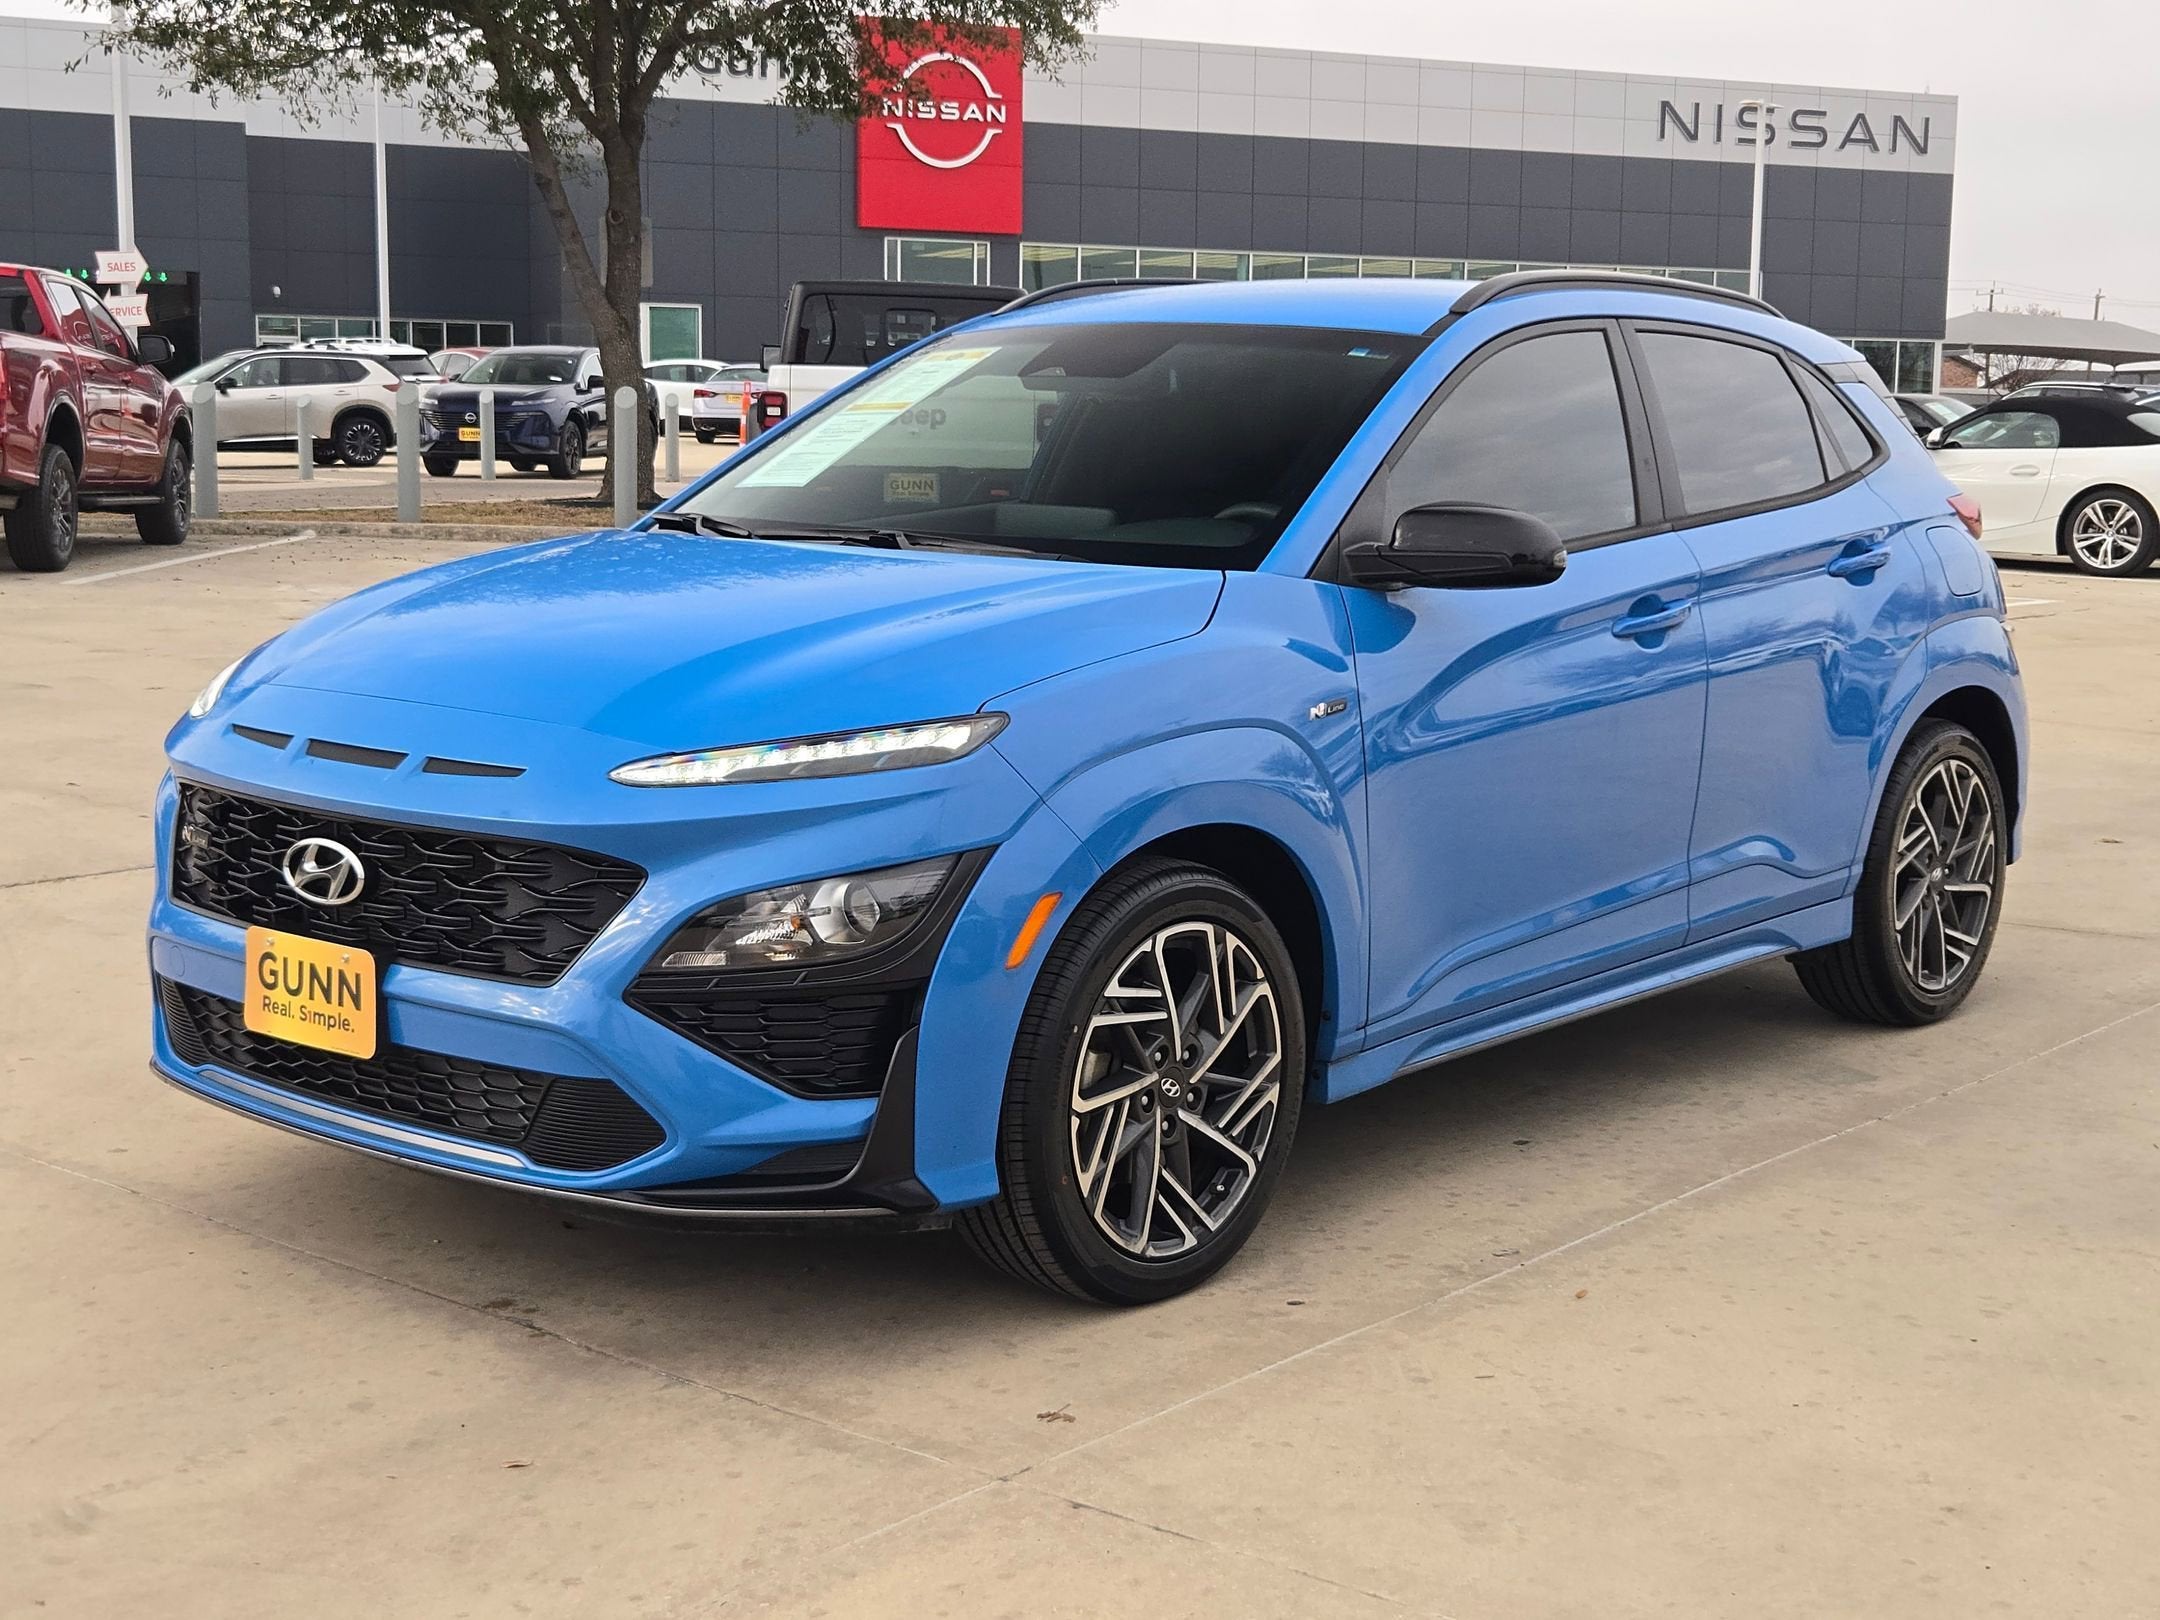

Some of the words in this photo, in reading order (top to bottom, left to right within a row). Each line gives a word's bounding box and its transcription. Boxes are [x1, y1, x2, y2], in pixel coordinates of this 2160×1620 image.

[882, 97, 1006, 123] NISSAN
[1658, 99, 1930, 155] NISSAN
[107, 262, 136, 272] SALES
[109, 306, 143, 317] ERVICE
[892, 408, 946, 430] eep
[890, 479, 934, 491] GUNN
[258, 951, 362, 1011] GUNN
[262, 995, 295, 1019] Real.
